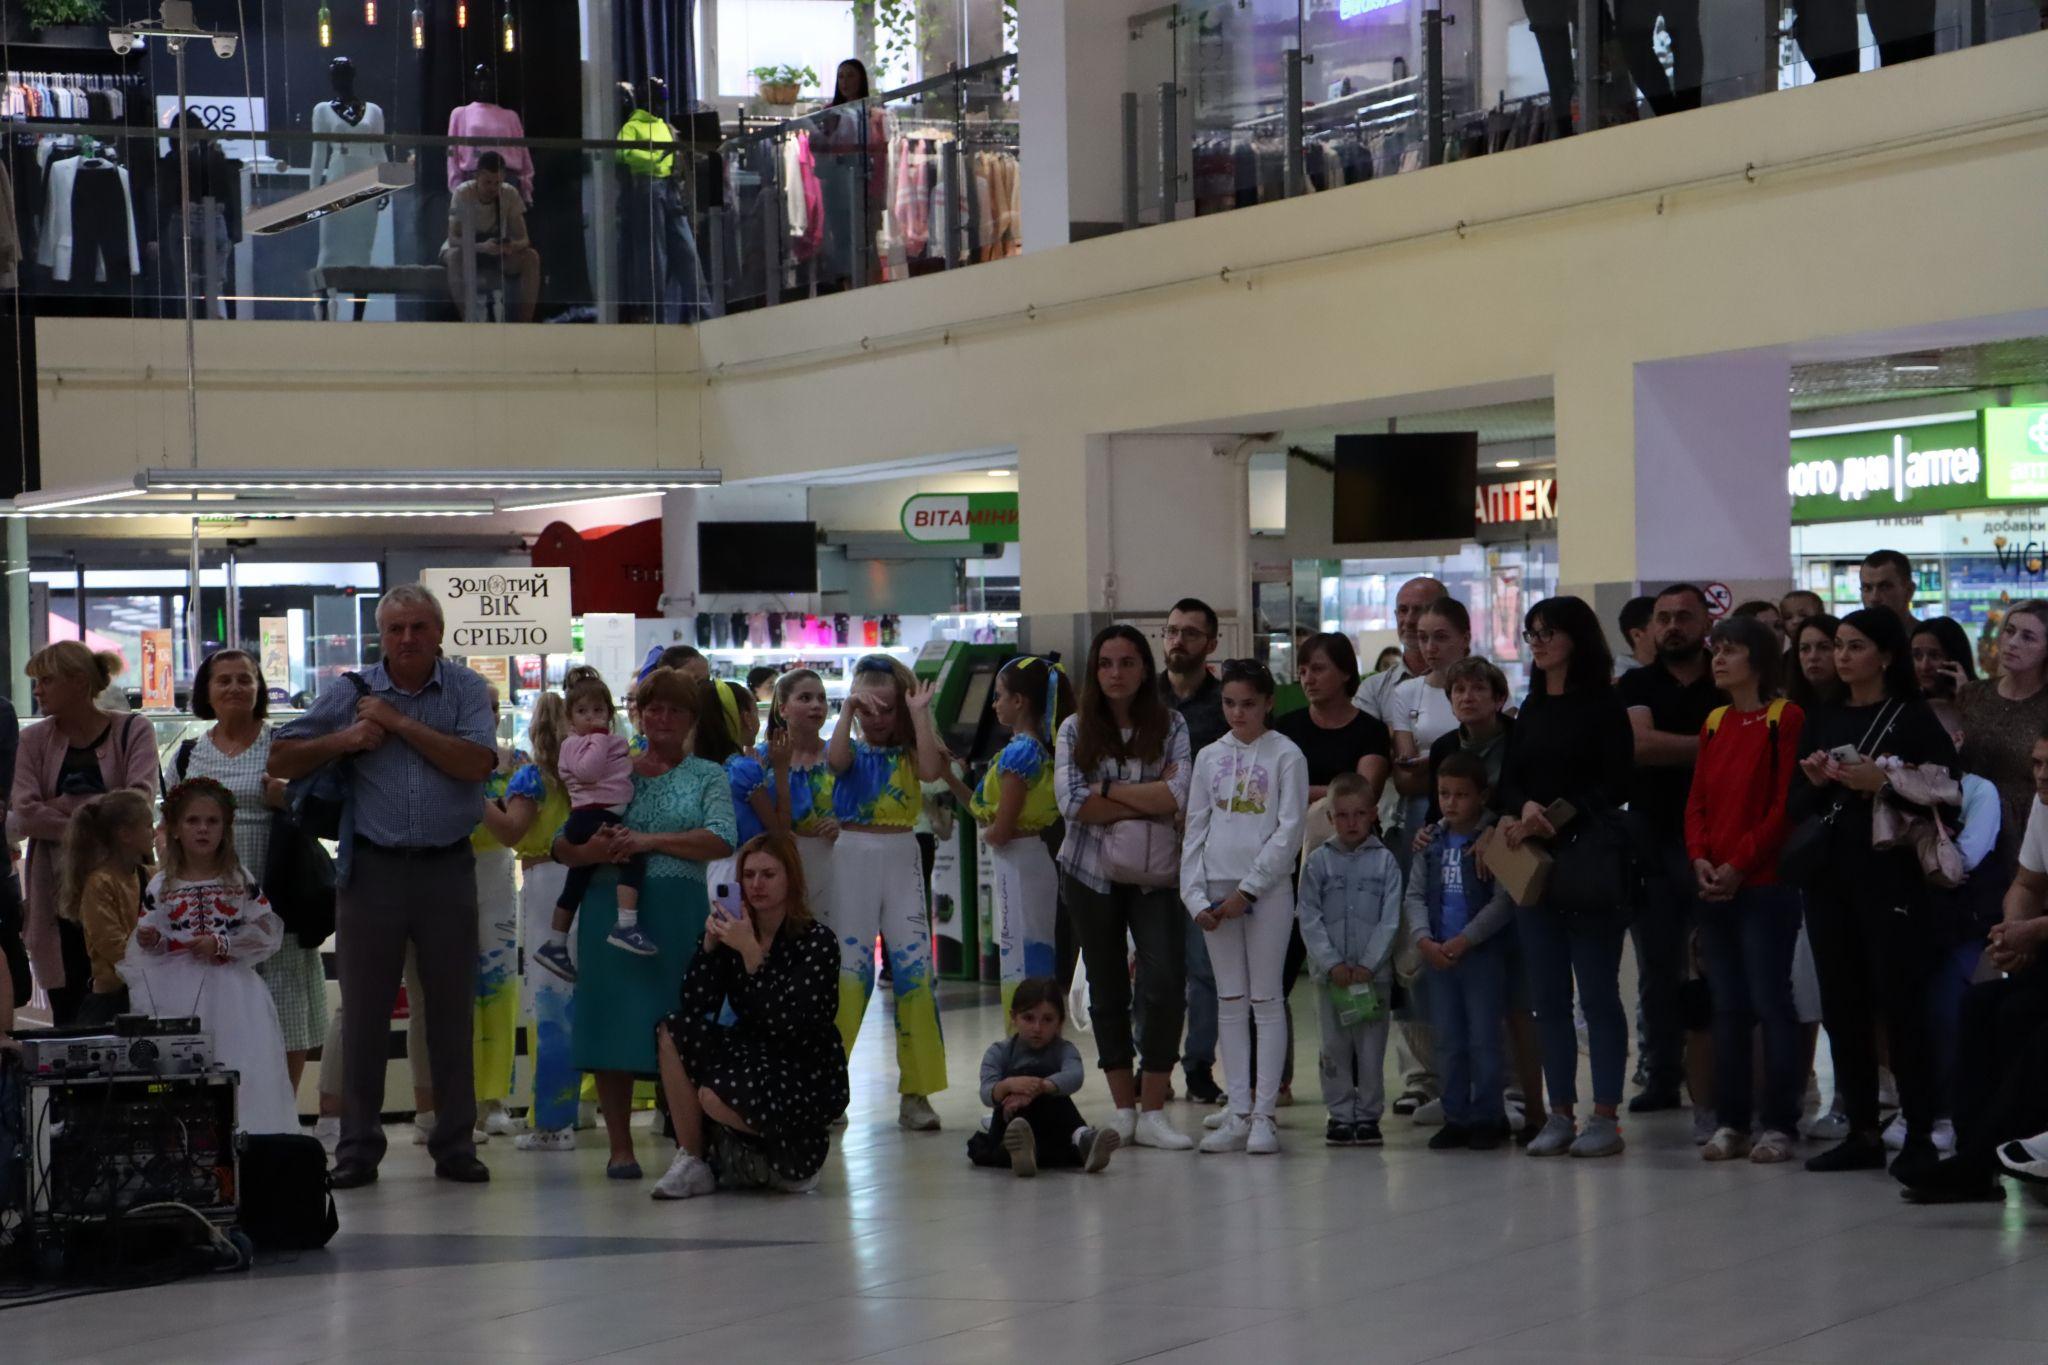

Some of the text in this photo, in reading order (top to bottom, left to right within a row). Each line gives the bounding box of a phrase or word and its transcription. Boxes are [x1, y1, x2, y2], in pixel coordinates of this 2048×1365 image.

[1789, 460, 1837, 496] ого
[1475, 479, 1558, 523] АПТЕК
[1983, 519, 2045, 534] добавки
[453, 627, 547, 646] СРІБЛО
